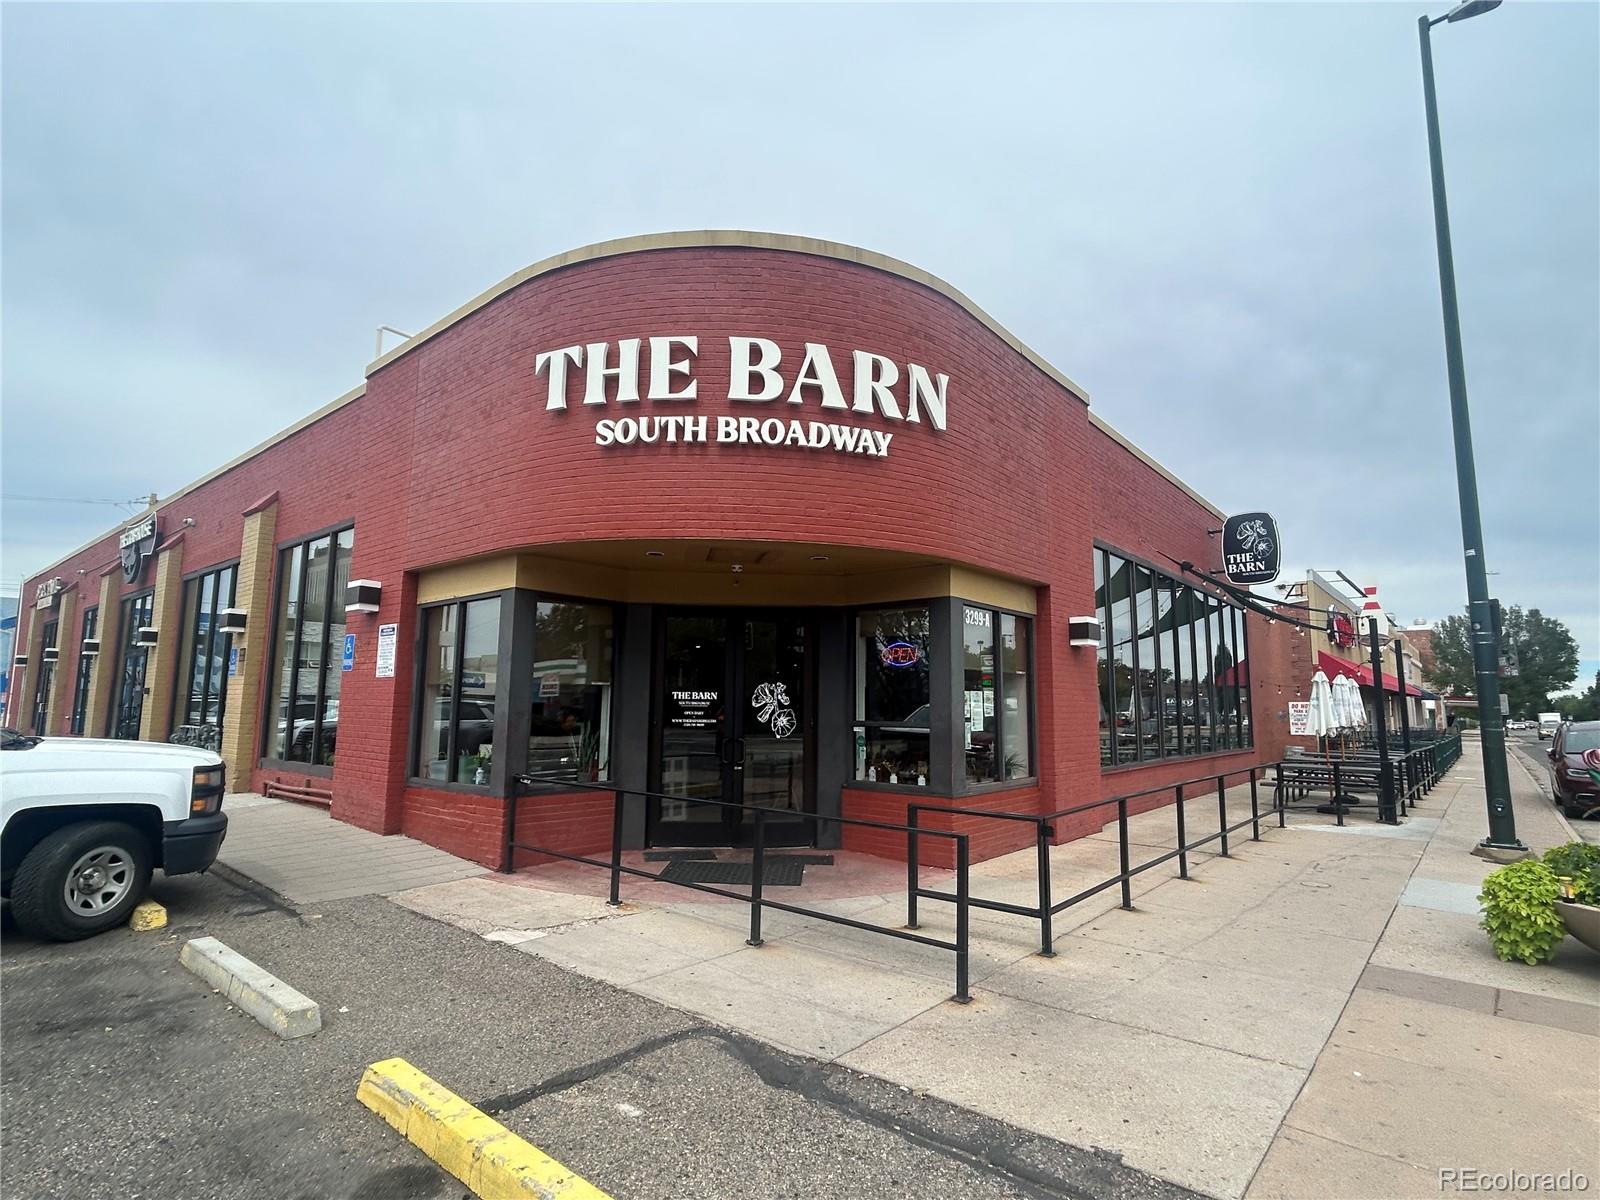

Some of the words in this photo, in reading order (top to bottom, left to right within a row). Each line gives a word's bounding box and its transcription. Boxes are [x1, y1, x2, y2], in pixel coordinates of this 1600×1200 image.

[535, 336, 698, 411] THE
[727, 336, 949, 431] BARN
[595, 416, 708, 448] SOUTH
[716, 417, 894, 457] BROADWAY
[1227, 552, 1254, 564] THE
[1228, 560, 1265, 574] BARN
[965, 608, 990, 627] 3299-A
[881, 646, 918, 663] OPEN
[671, 691, 691, 700] THE
[691, 691, 718, 700] BARN
